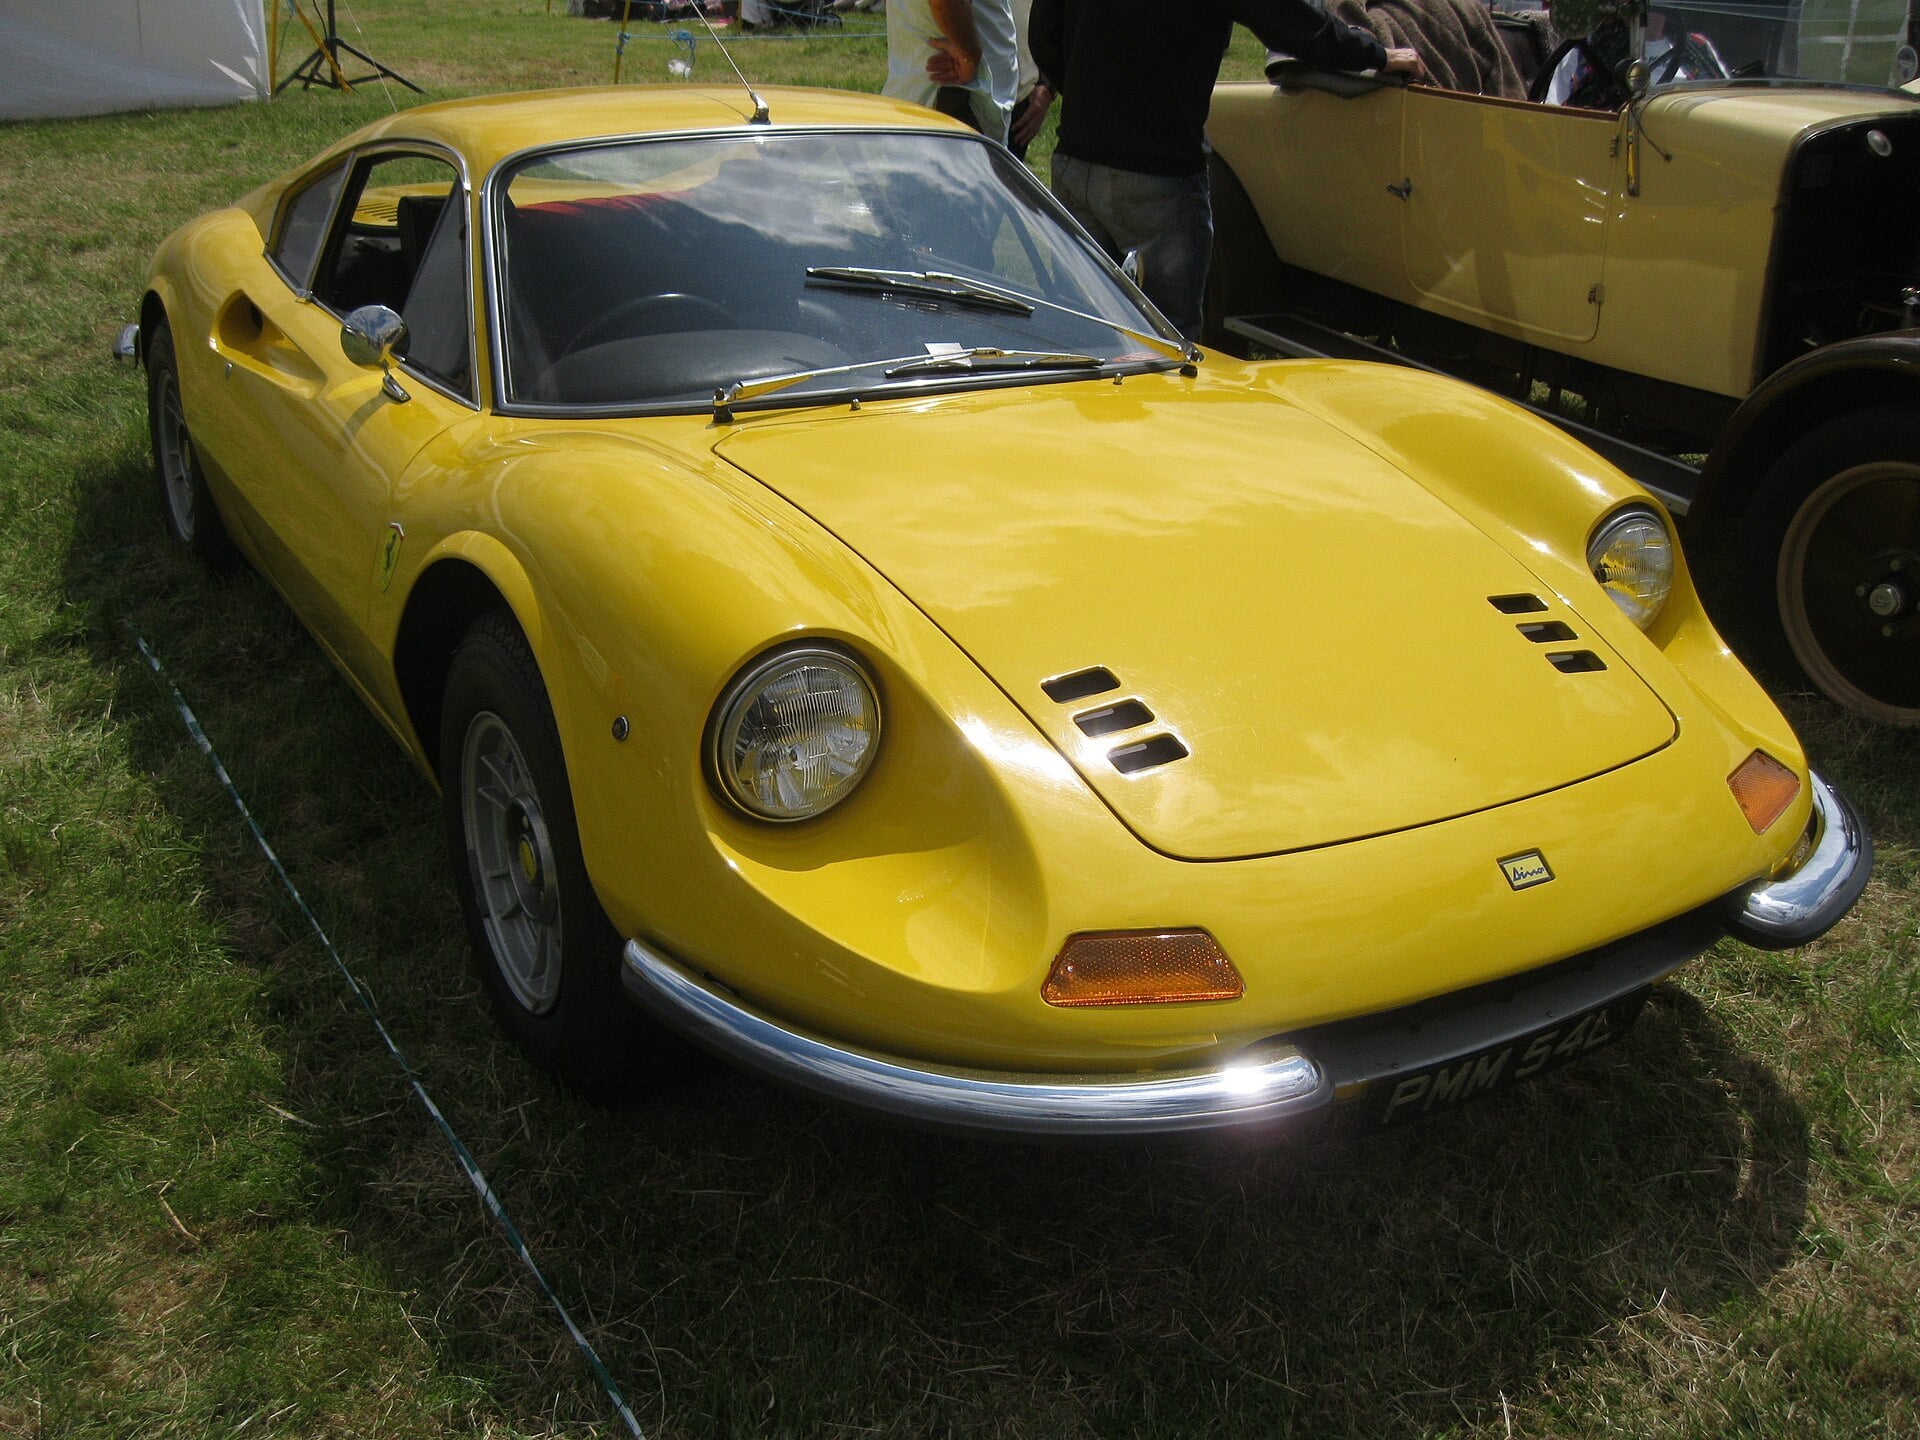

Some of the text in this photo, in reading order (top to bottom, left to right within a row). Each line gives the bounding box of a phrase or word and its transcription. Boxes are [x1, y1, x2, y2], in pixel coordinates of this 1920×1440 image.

[1512, 866, 1545, 882] Dino
[1380, 1010, 1612, 1124] PMM 54L
